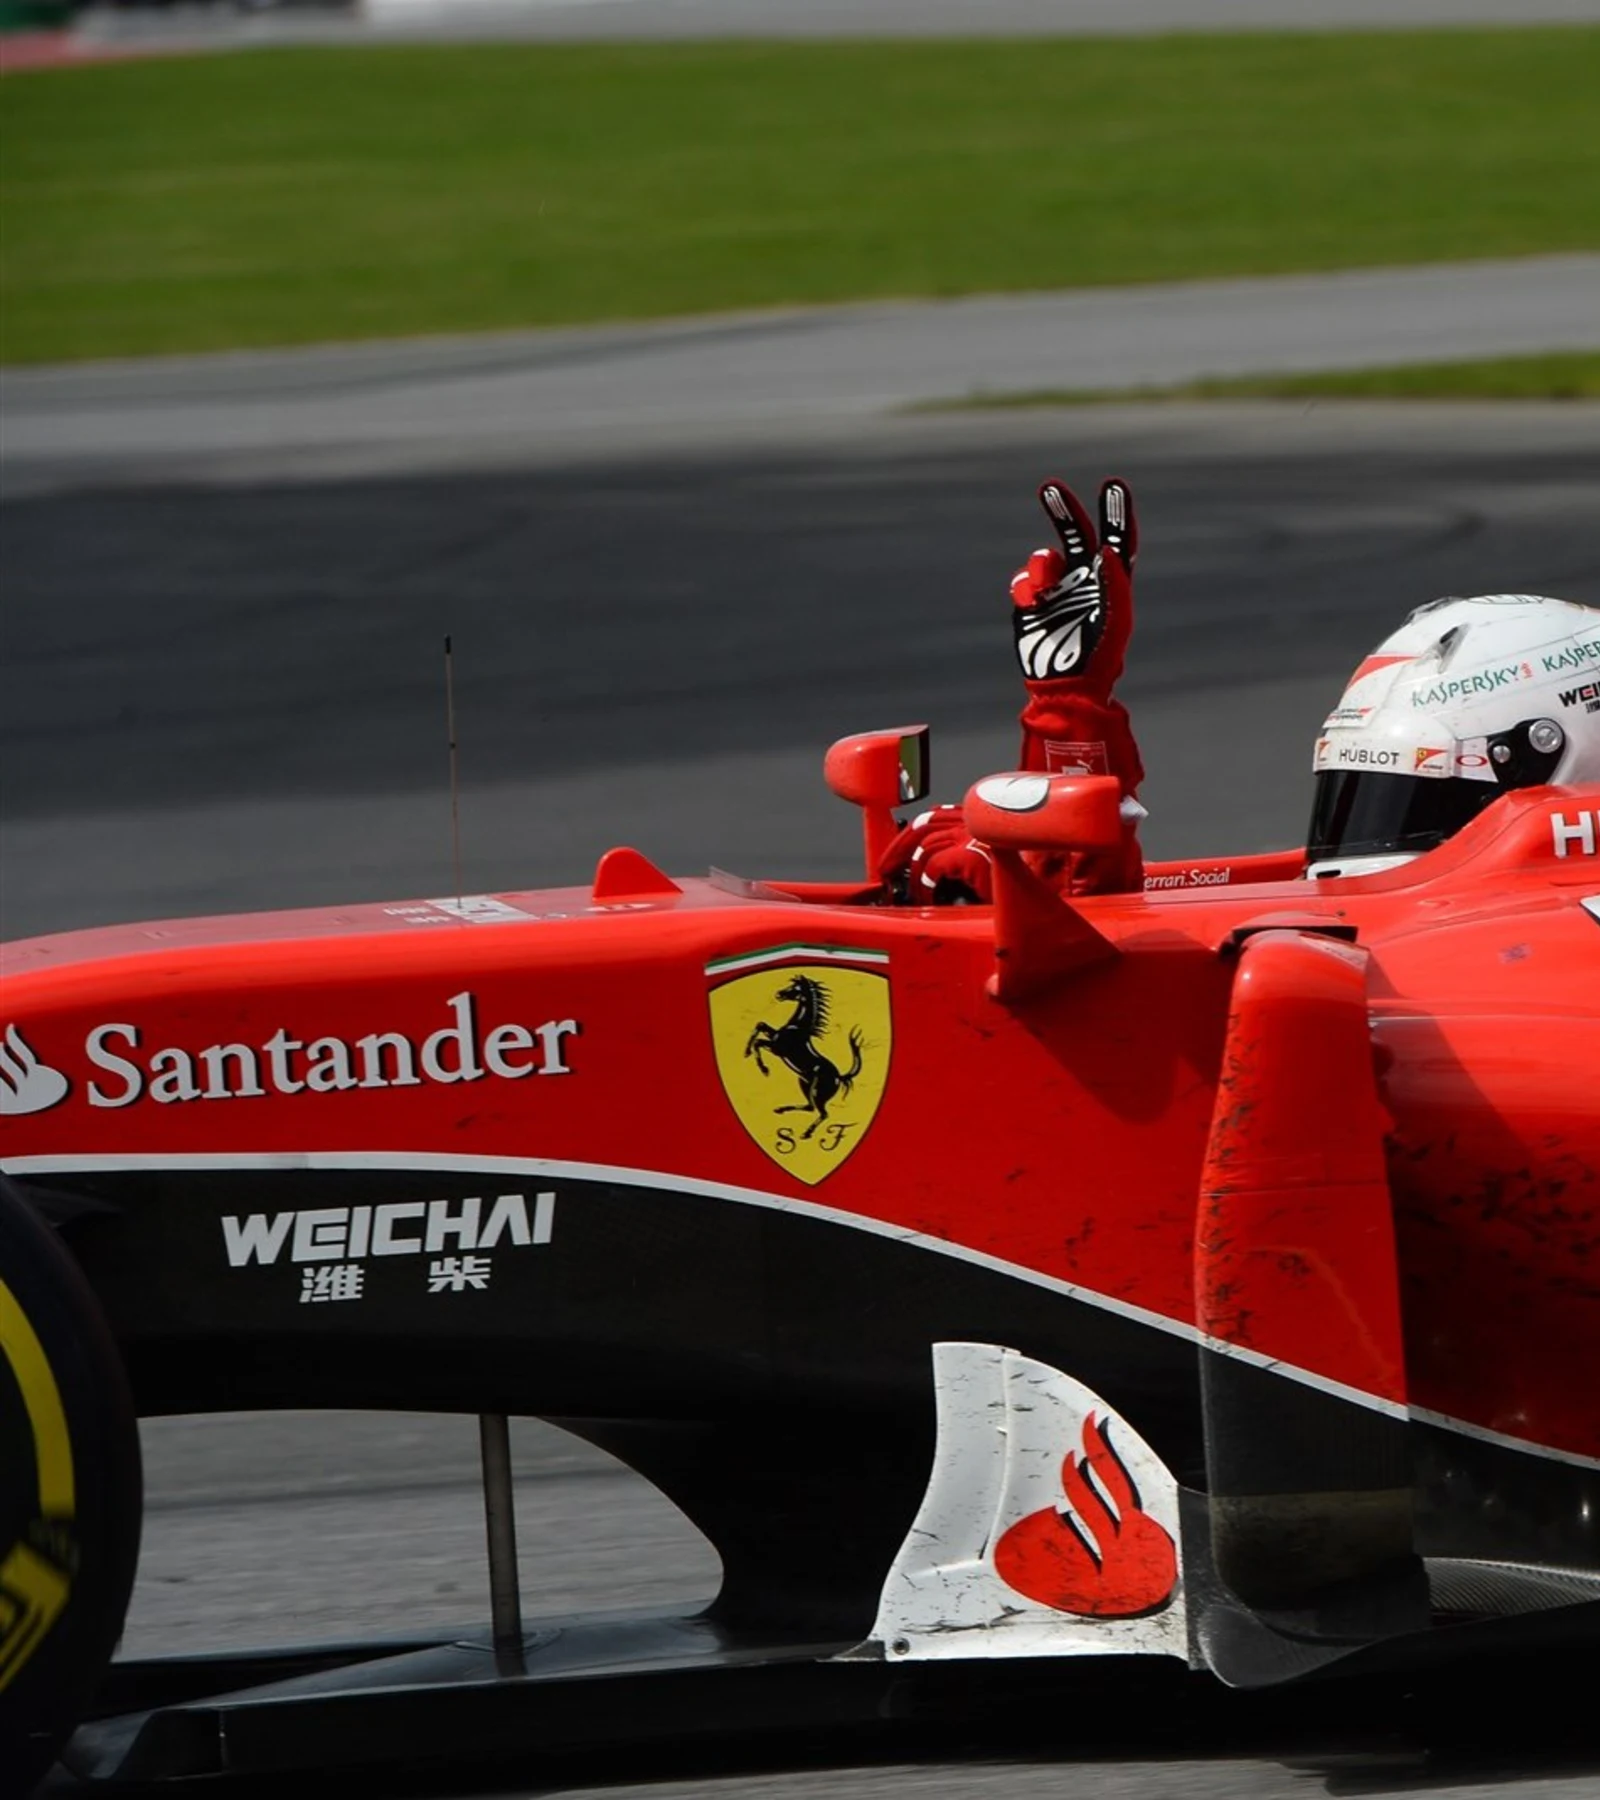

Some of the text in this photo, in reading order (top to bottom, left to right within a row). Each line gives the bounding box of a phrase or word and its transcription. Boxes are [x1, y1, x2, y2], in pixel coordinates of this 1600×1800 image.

[1338, 749, 1399, 766] HUBLOT
[1143, 867, 1230, 889] errari.Social
[85, 991, 578, 1108] Santander
[221, 1191, 556, 1267] WEICHAI
